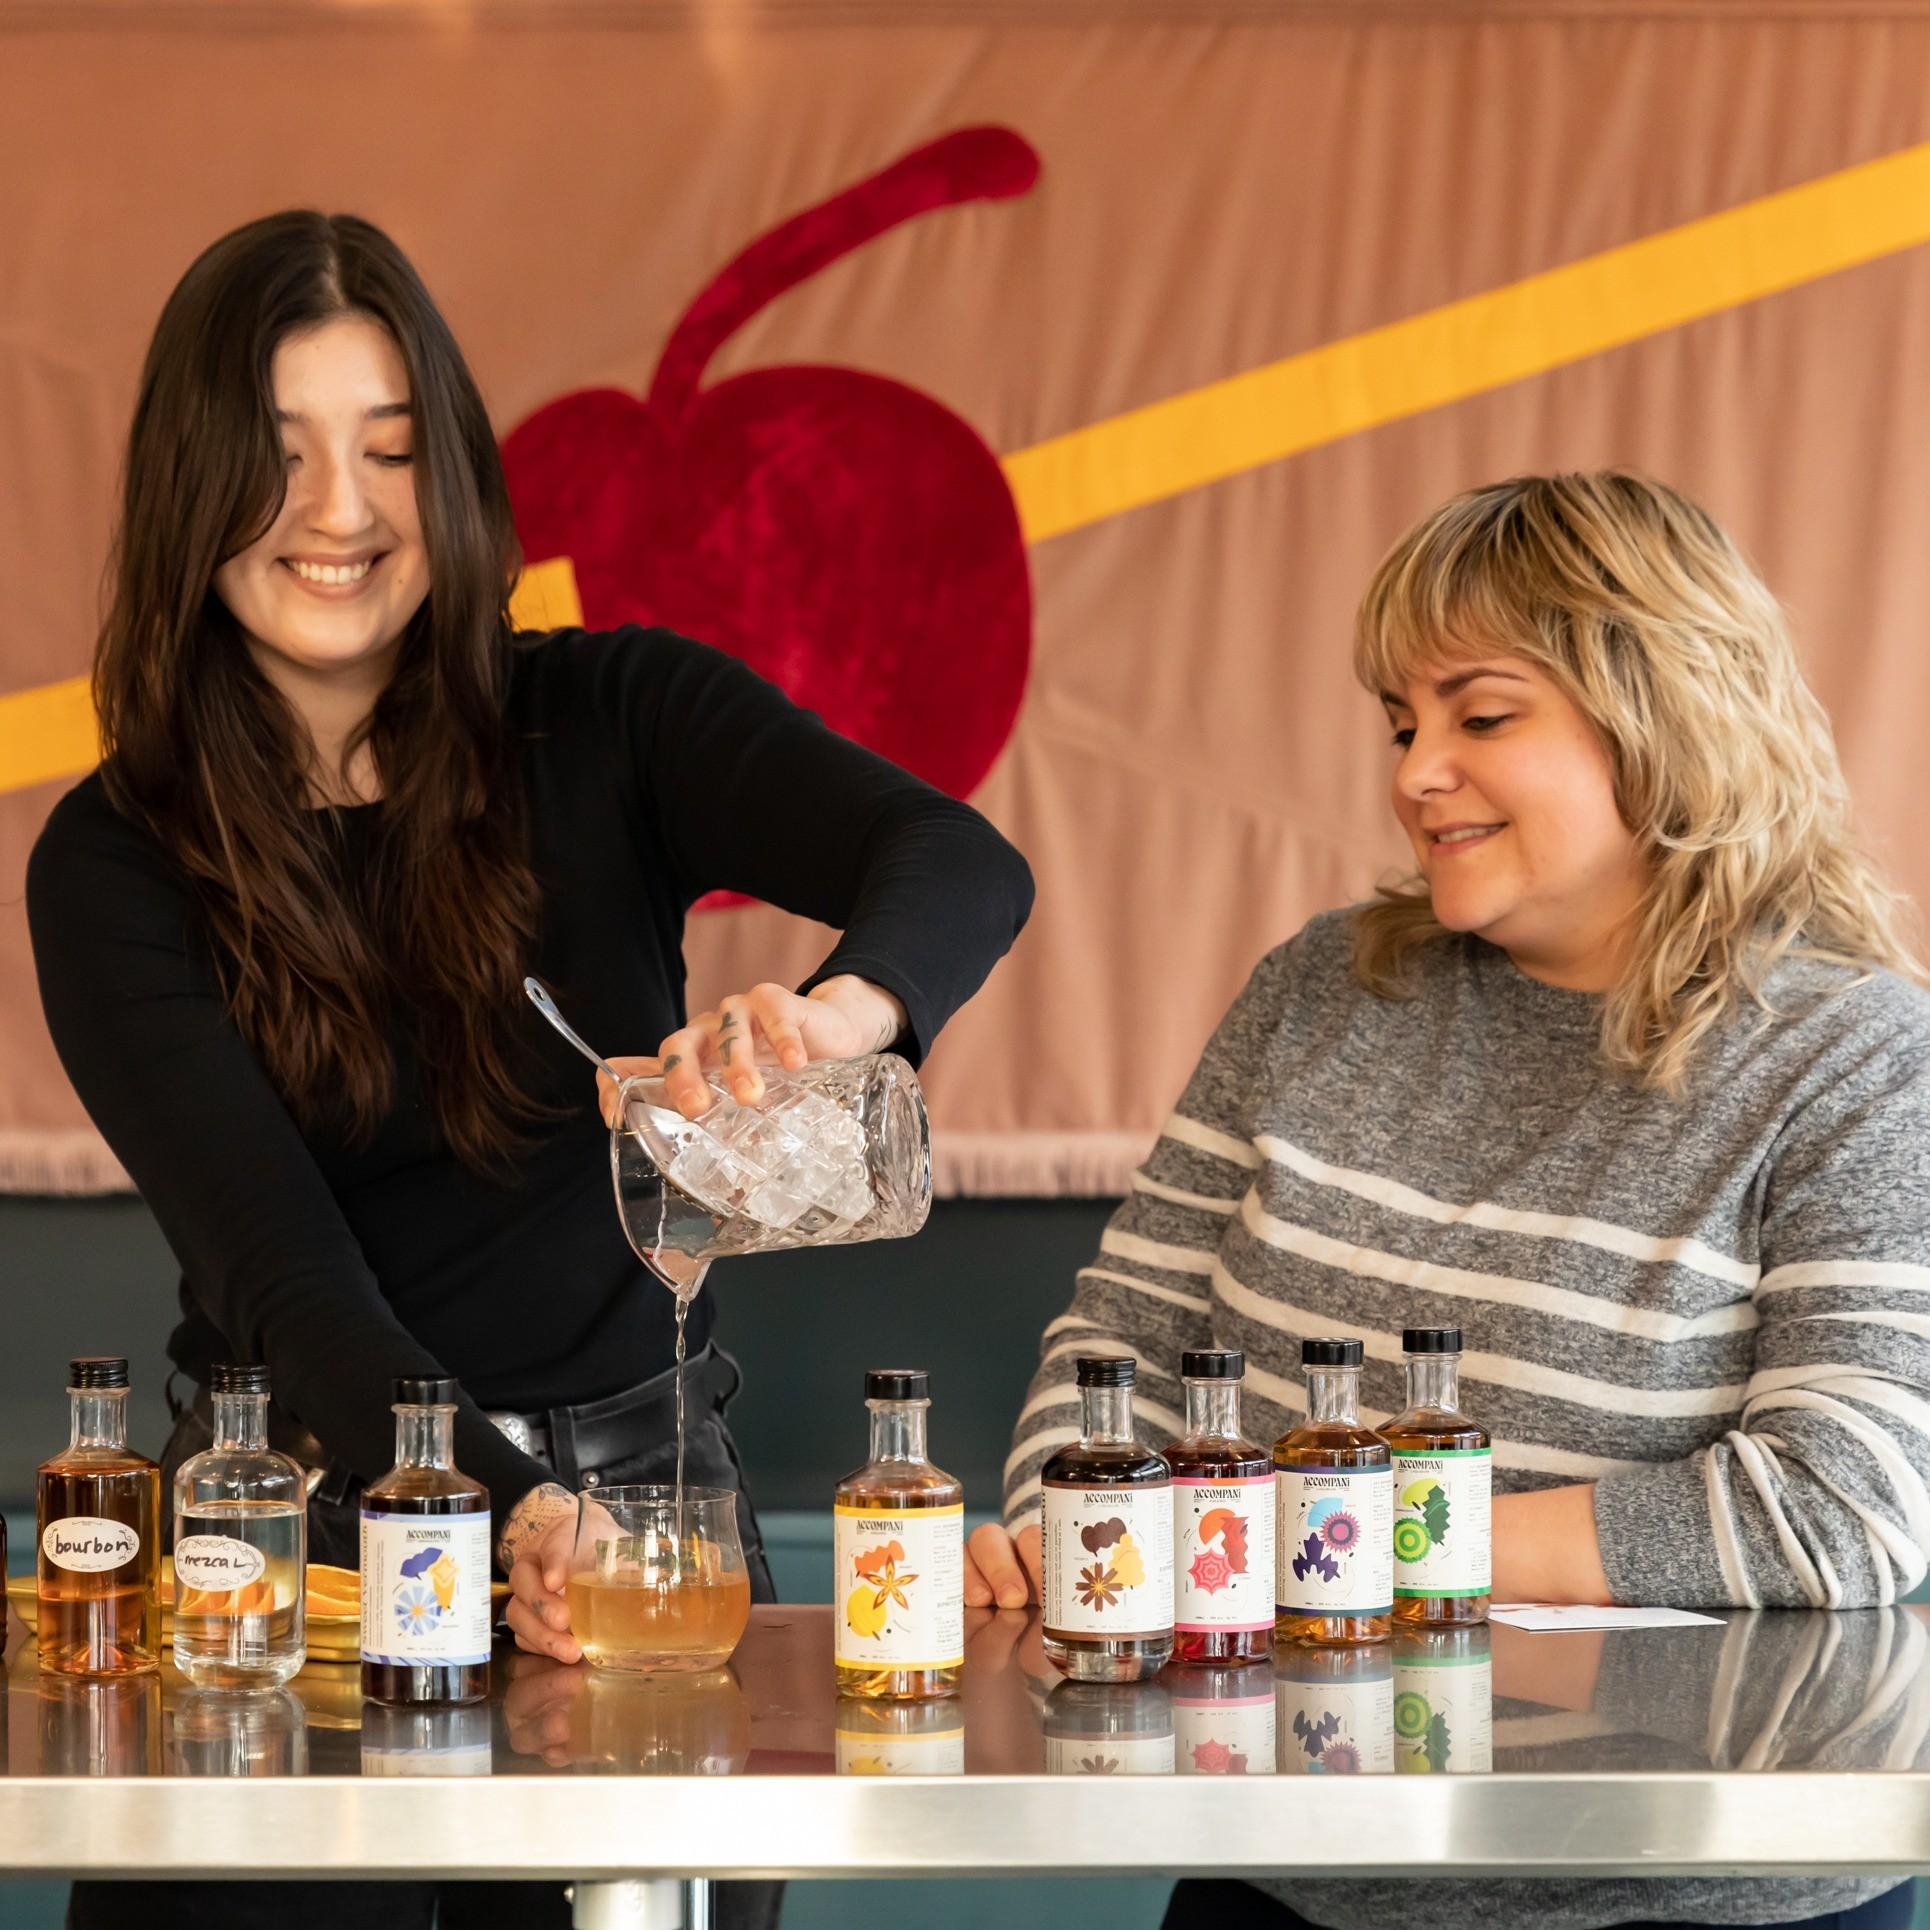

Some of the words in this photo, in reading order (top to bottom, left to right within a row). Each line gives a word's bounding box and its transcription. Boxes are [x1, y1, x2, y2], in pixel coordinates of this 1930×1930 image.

[1398, 1459, 1444, 1470] ACCOMPANi
[1303, 1476, 1350, 1487] ACCOMPANi
[1083, 1493, 1133, 1504] ACCOMPANi
[1193, 1488, 1241, 1499] ACCOMPANi
[55, 1533, 130, 1555] bourbon
